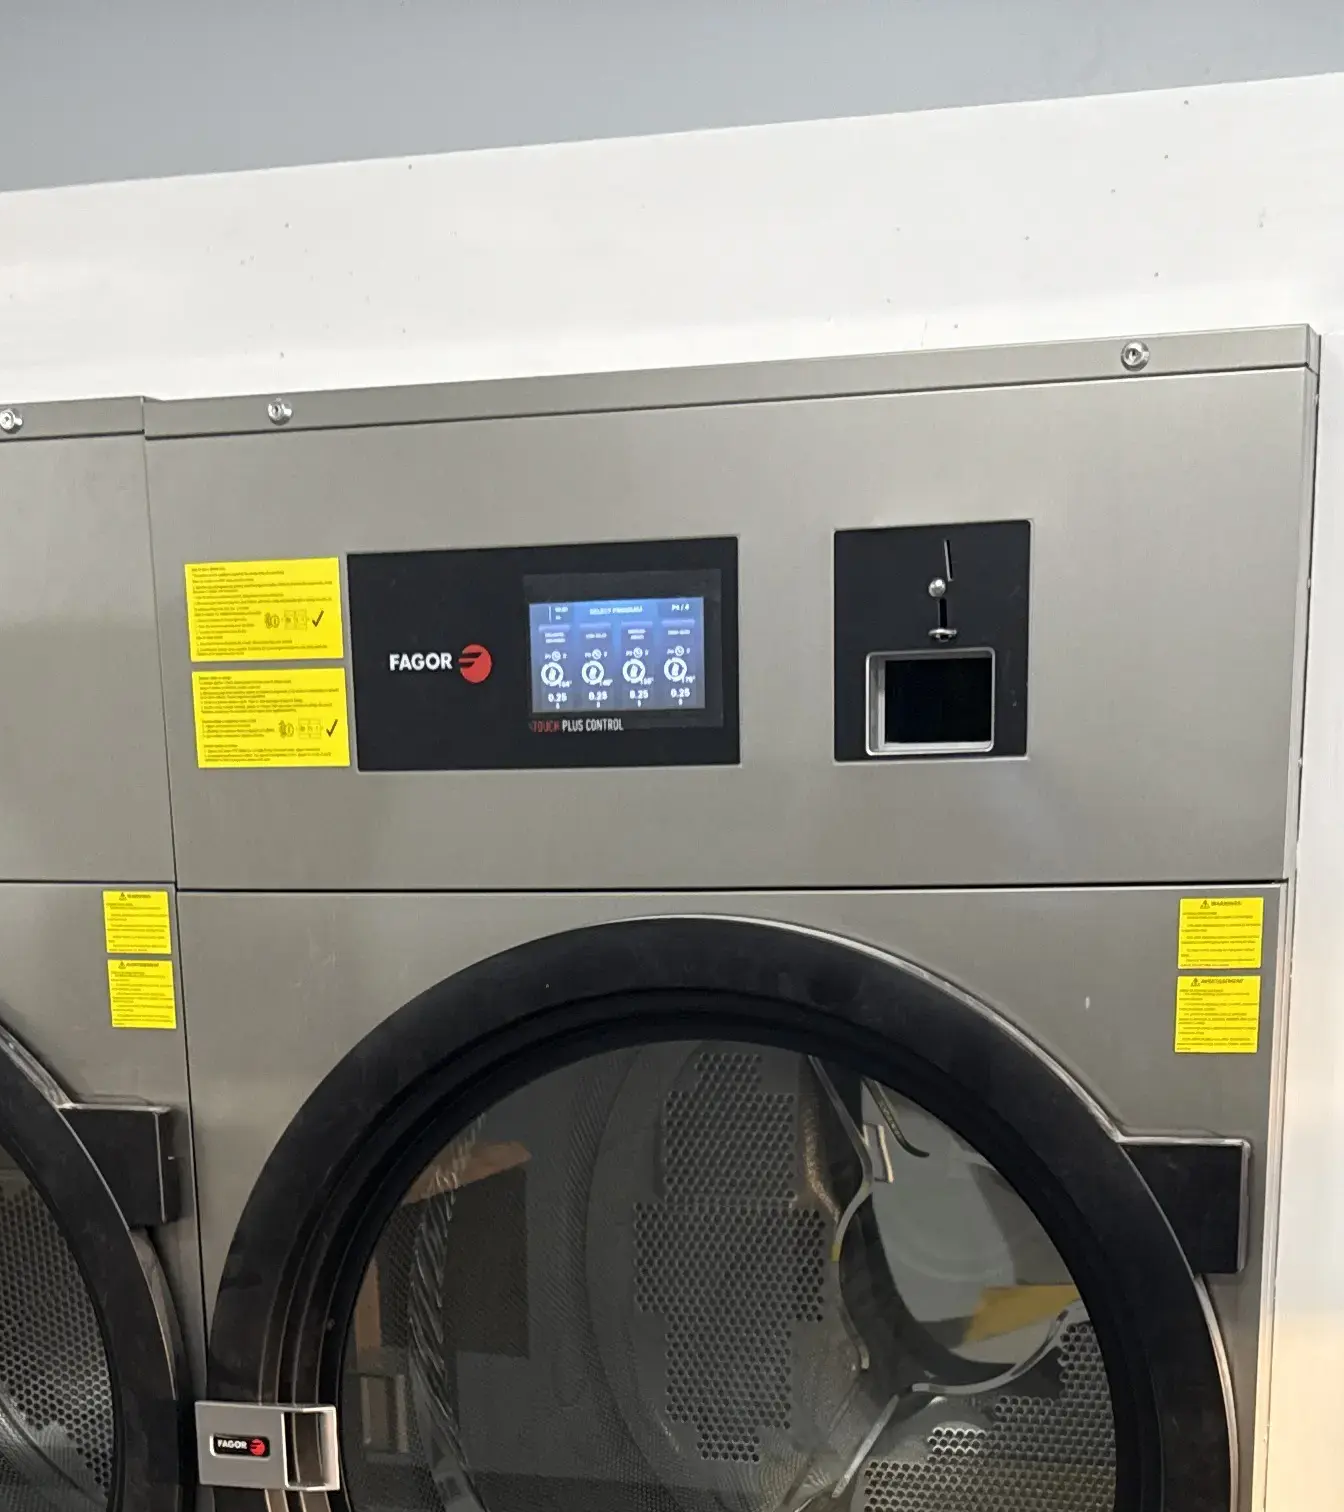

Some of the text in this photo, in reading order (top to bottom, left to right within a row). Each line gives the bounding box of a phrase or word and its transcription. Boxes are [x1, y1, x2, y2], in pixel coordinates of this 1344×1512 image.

[389, 652, 453, 671] FAGOR
[561, 718, 584, 732] PLUS
[585, 717, 624, 732] CONTROL
[217, 1439, 248, 1449] FAGOR
